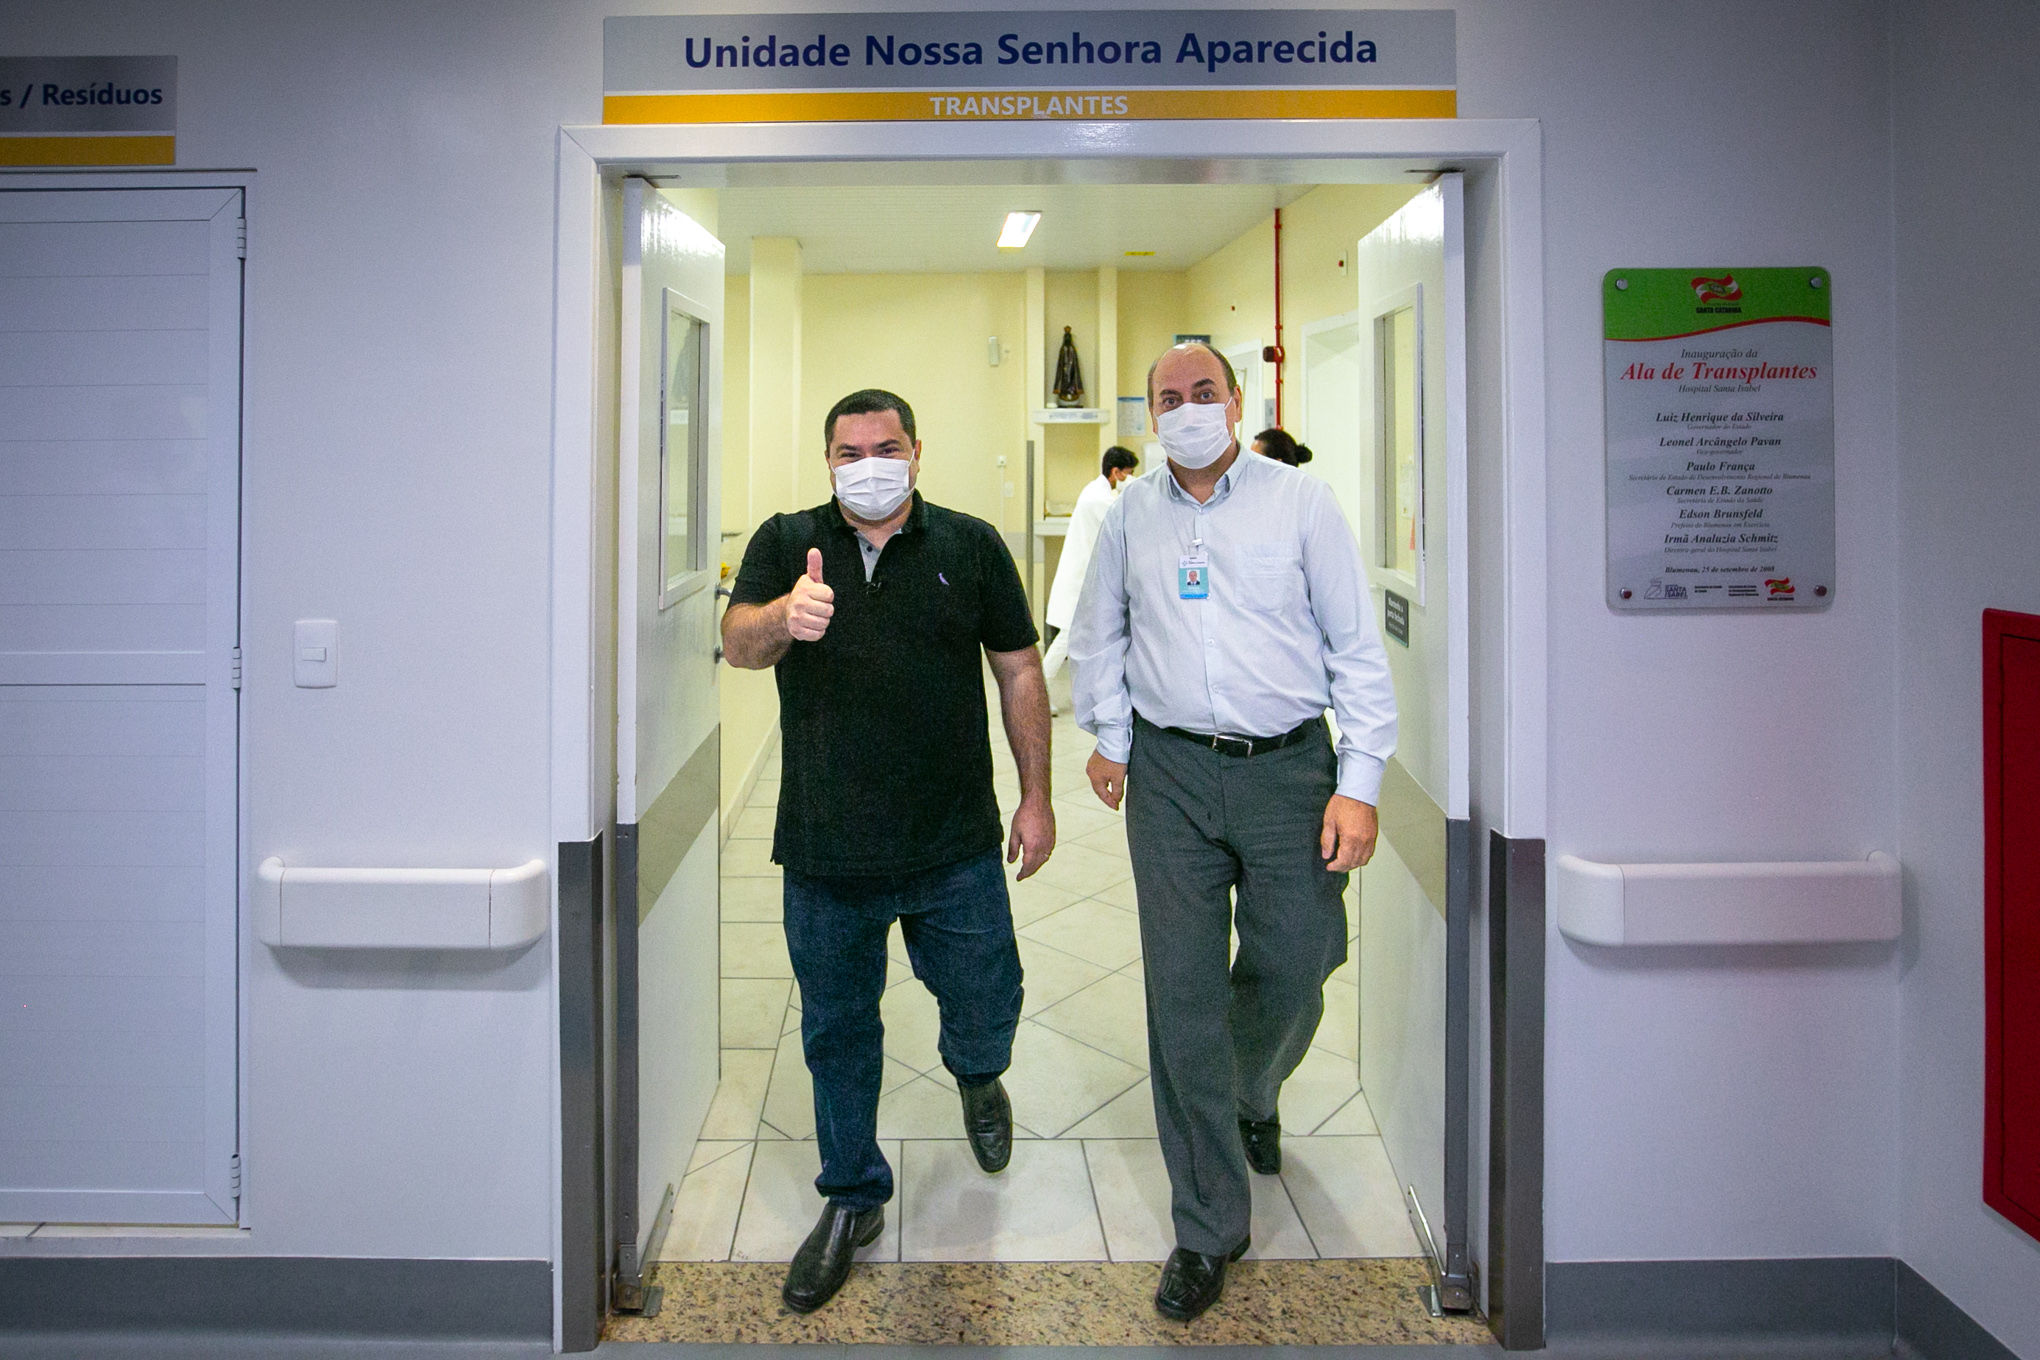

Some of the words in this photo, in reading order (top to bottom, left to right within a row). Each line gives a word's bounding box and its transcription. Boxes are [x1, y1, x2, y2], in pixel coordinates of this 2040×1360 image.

[685, 34, 851, 68] Unidade
[865, 35, 983, 66] Nossa
[997, 32, 1162, 65] Senhora
[1175, 31, 1377, 73] Aparecida
[42, 82, 163, 106] Resíduos
[929, 95, 1128, 116] TRANSPLANTES
[1680, 348, 1743, 360] Inauguração
[1745, 348, 1758, 358] da
[1620, 362, 1655, 380] Ala
[1661, 362, 1685, 380] de
[1692, 362, 1818, 384] Transplantes
[1678, 384, 1711, 394] Hospital
[1713, 384, 1735, 393] Santa
[1737, 384, 1761, 393] Isabel
[1656, 412, 1678, 422] Luiz
[1681, 412, 1729, 424] Henrique
[1731, 412, 1743, 422] da
[1746, 411, 1784, 422] Silveira
[1659, 437, 1694, 447] Leonel
[1696, 437, 1747, 449] Arcângelo
[1750, 437, 1781, 447] Pavan
[1686, 461, 1716, 471] Paulo
[1719, 461, 1755, 473] França
[1666, 486, 1706, 496] Carmen
[1709, 486, 1730, 495] E.B.
[1734, 485, 1773, 495] Zanotto
[1679, 509, 1710, 519] Edson
[1713, 508, 1763, 521] Brunsfeld
[1664, 533, 1689, 544] Irmã
[1692, 533, 1736, 544] Analuzia
[1738, 532, 1779, 544] Schmitz
[1665, 566, 1700, 574] Blumenau,
